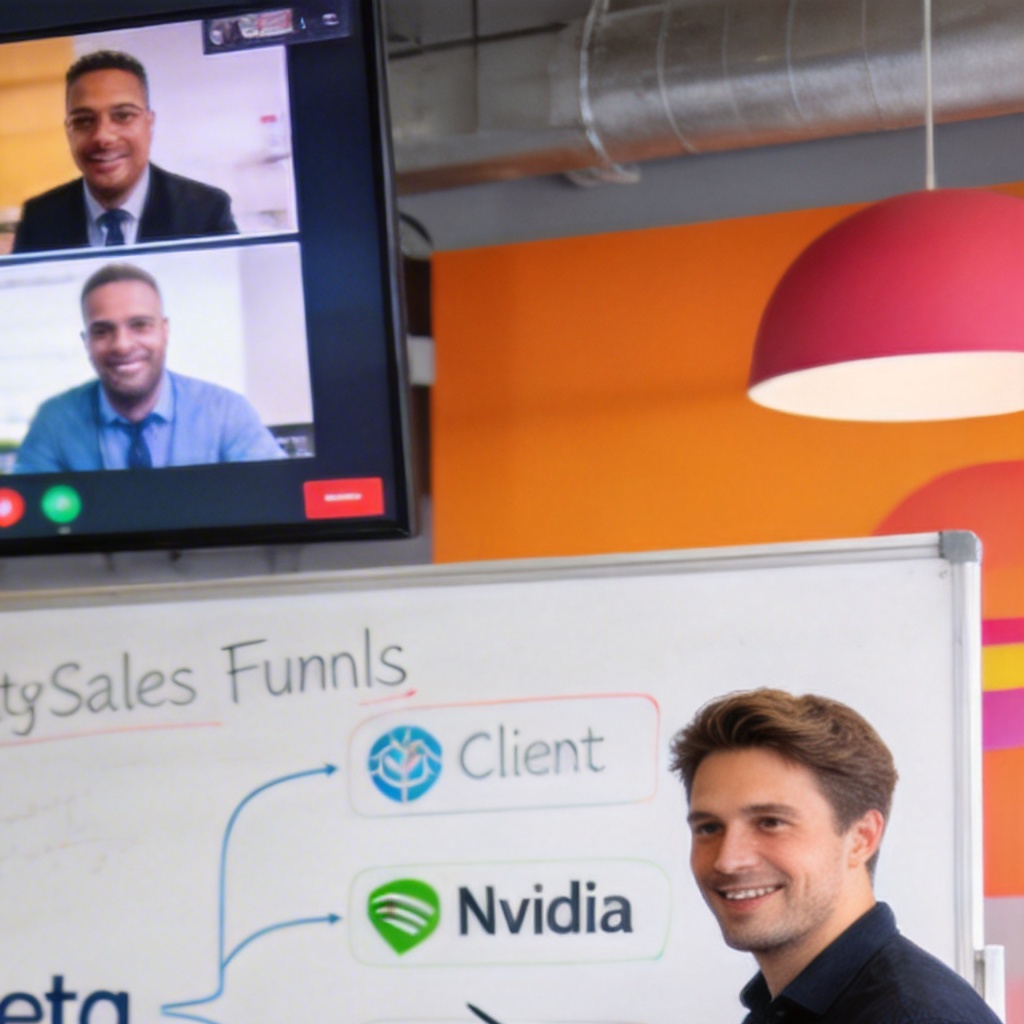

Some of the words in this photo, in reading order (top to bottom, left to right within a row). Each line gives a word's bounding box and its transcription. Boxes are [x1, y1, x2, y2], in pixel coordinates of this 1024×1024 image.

[221, 627, 408, 704] Funnls
[459, 724, 606, 780] Client
[458, 880, 633, 936] Nvidia
